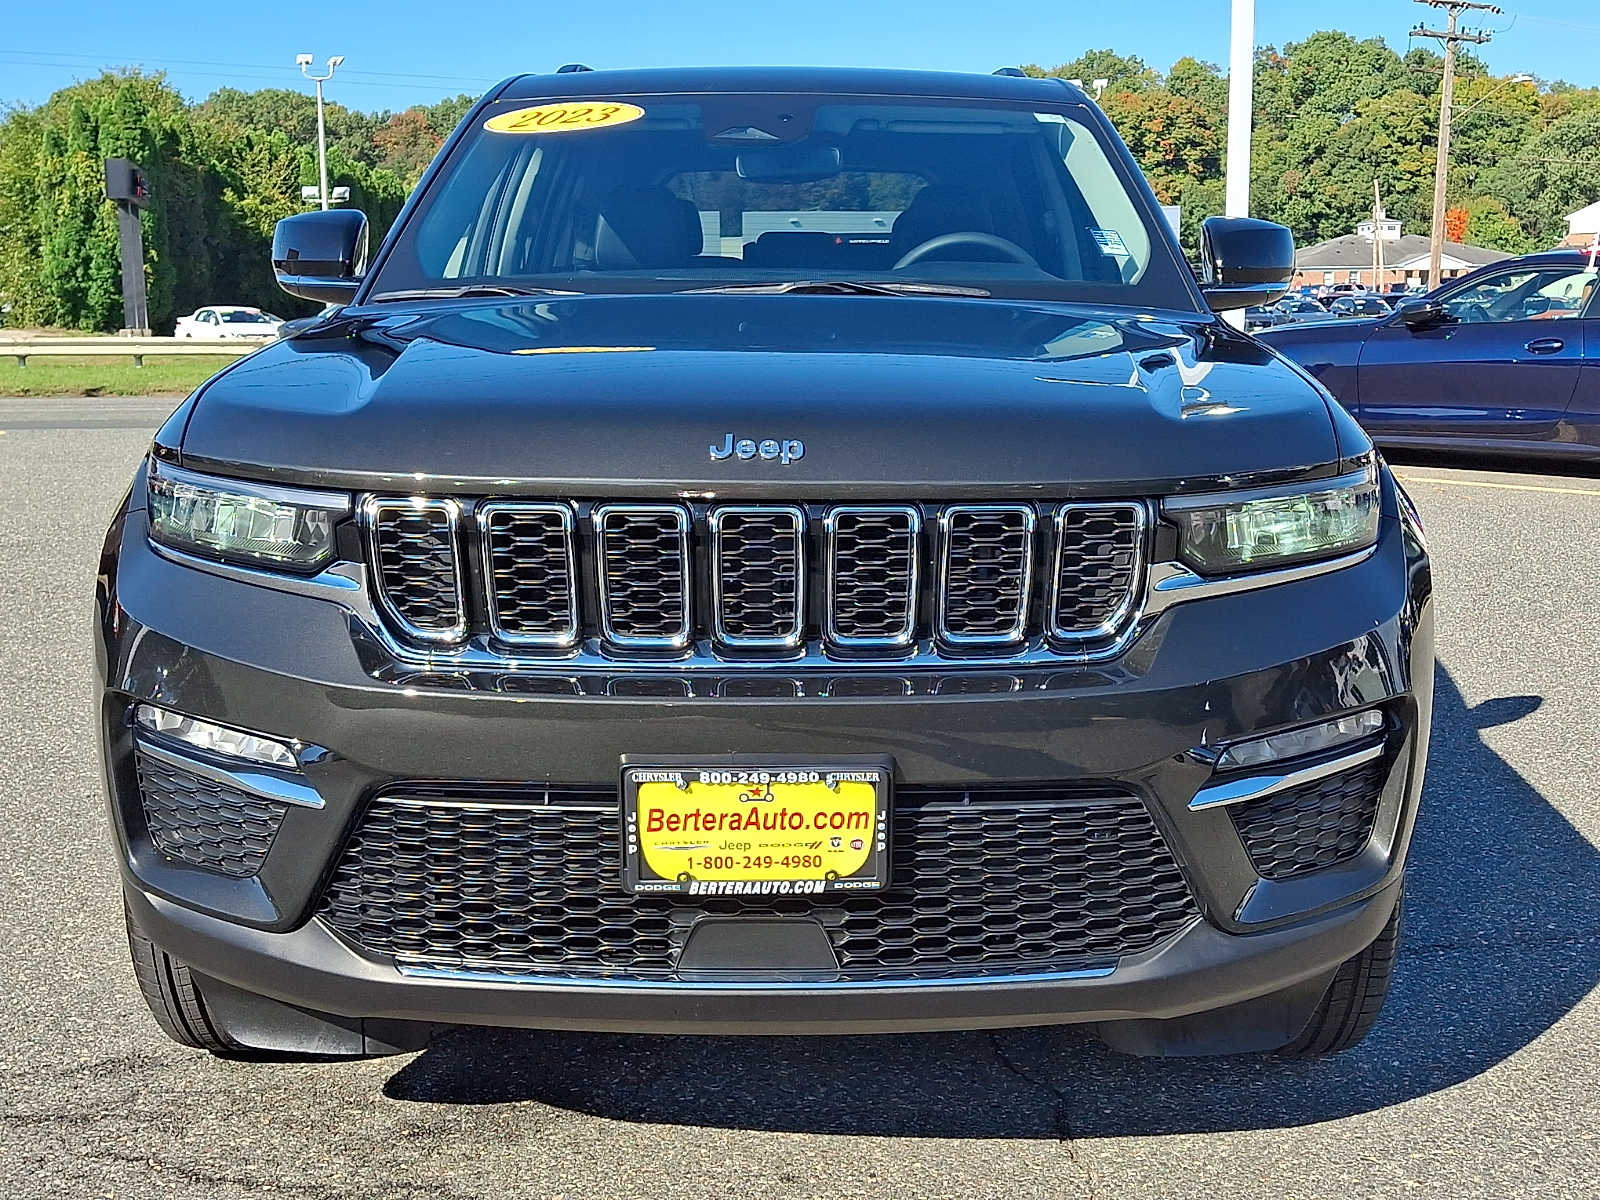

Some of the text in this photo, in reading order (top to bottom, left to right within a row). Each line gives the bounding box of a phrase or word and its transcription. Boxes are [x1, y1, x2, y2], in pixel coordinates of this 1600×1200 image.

[508, 107, 620, 129] 2023
[709, 432, 805, 465] Jeep
[631, 772, 682, 782] CHRYSLER
[700, 772, 820, 784] 800-249-4980
[831, 772, 880, 781] CHRYSLER
[646, 807, 870, 833] BerteraAuto.com
[627, 811, 638, 855] Jeep
[877, 810, 887, 852] Jeep
[719, 840, 752, 852] Jeep
[687, 855, 823, 870] 1-800-249-4980
[688, 880, 827, 896] BERTERAAUTO.COM
